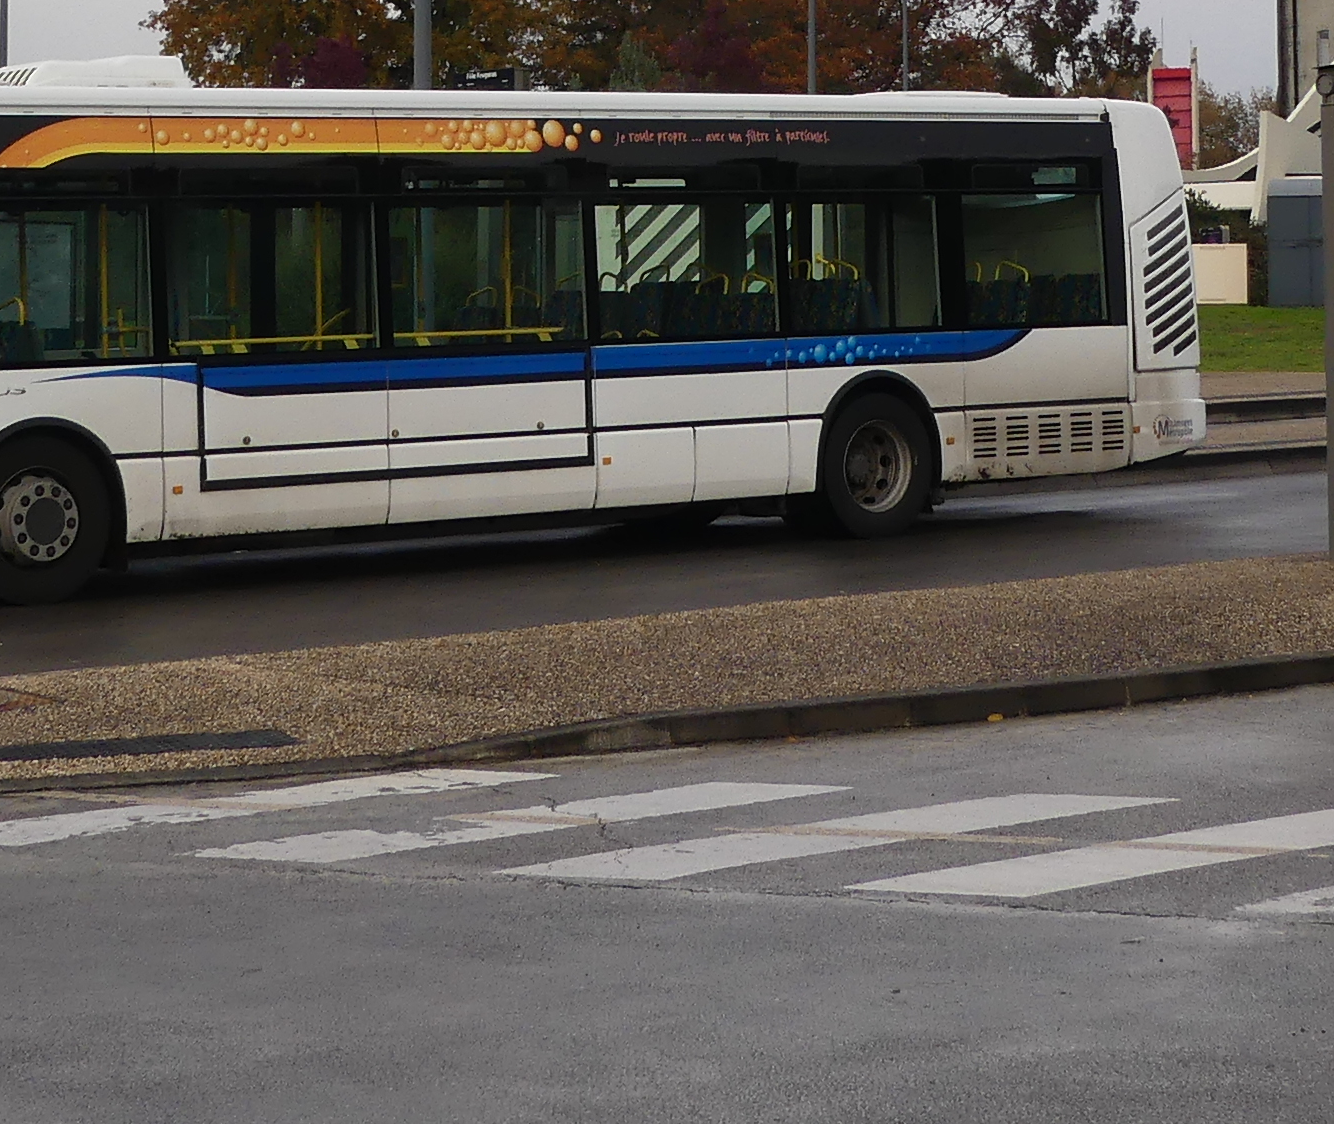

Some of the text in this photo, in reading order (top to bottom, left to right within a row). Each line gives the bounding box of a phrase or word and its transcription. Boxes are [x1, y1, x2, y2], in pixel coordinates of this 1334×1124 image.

[628, 130, 655, 143] roule
[656, 132, 687, 146] propre
[706, 133, 725, 143] avec
[728, 132, 743, 143] un
[745, 129, 770, 146] filtre
